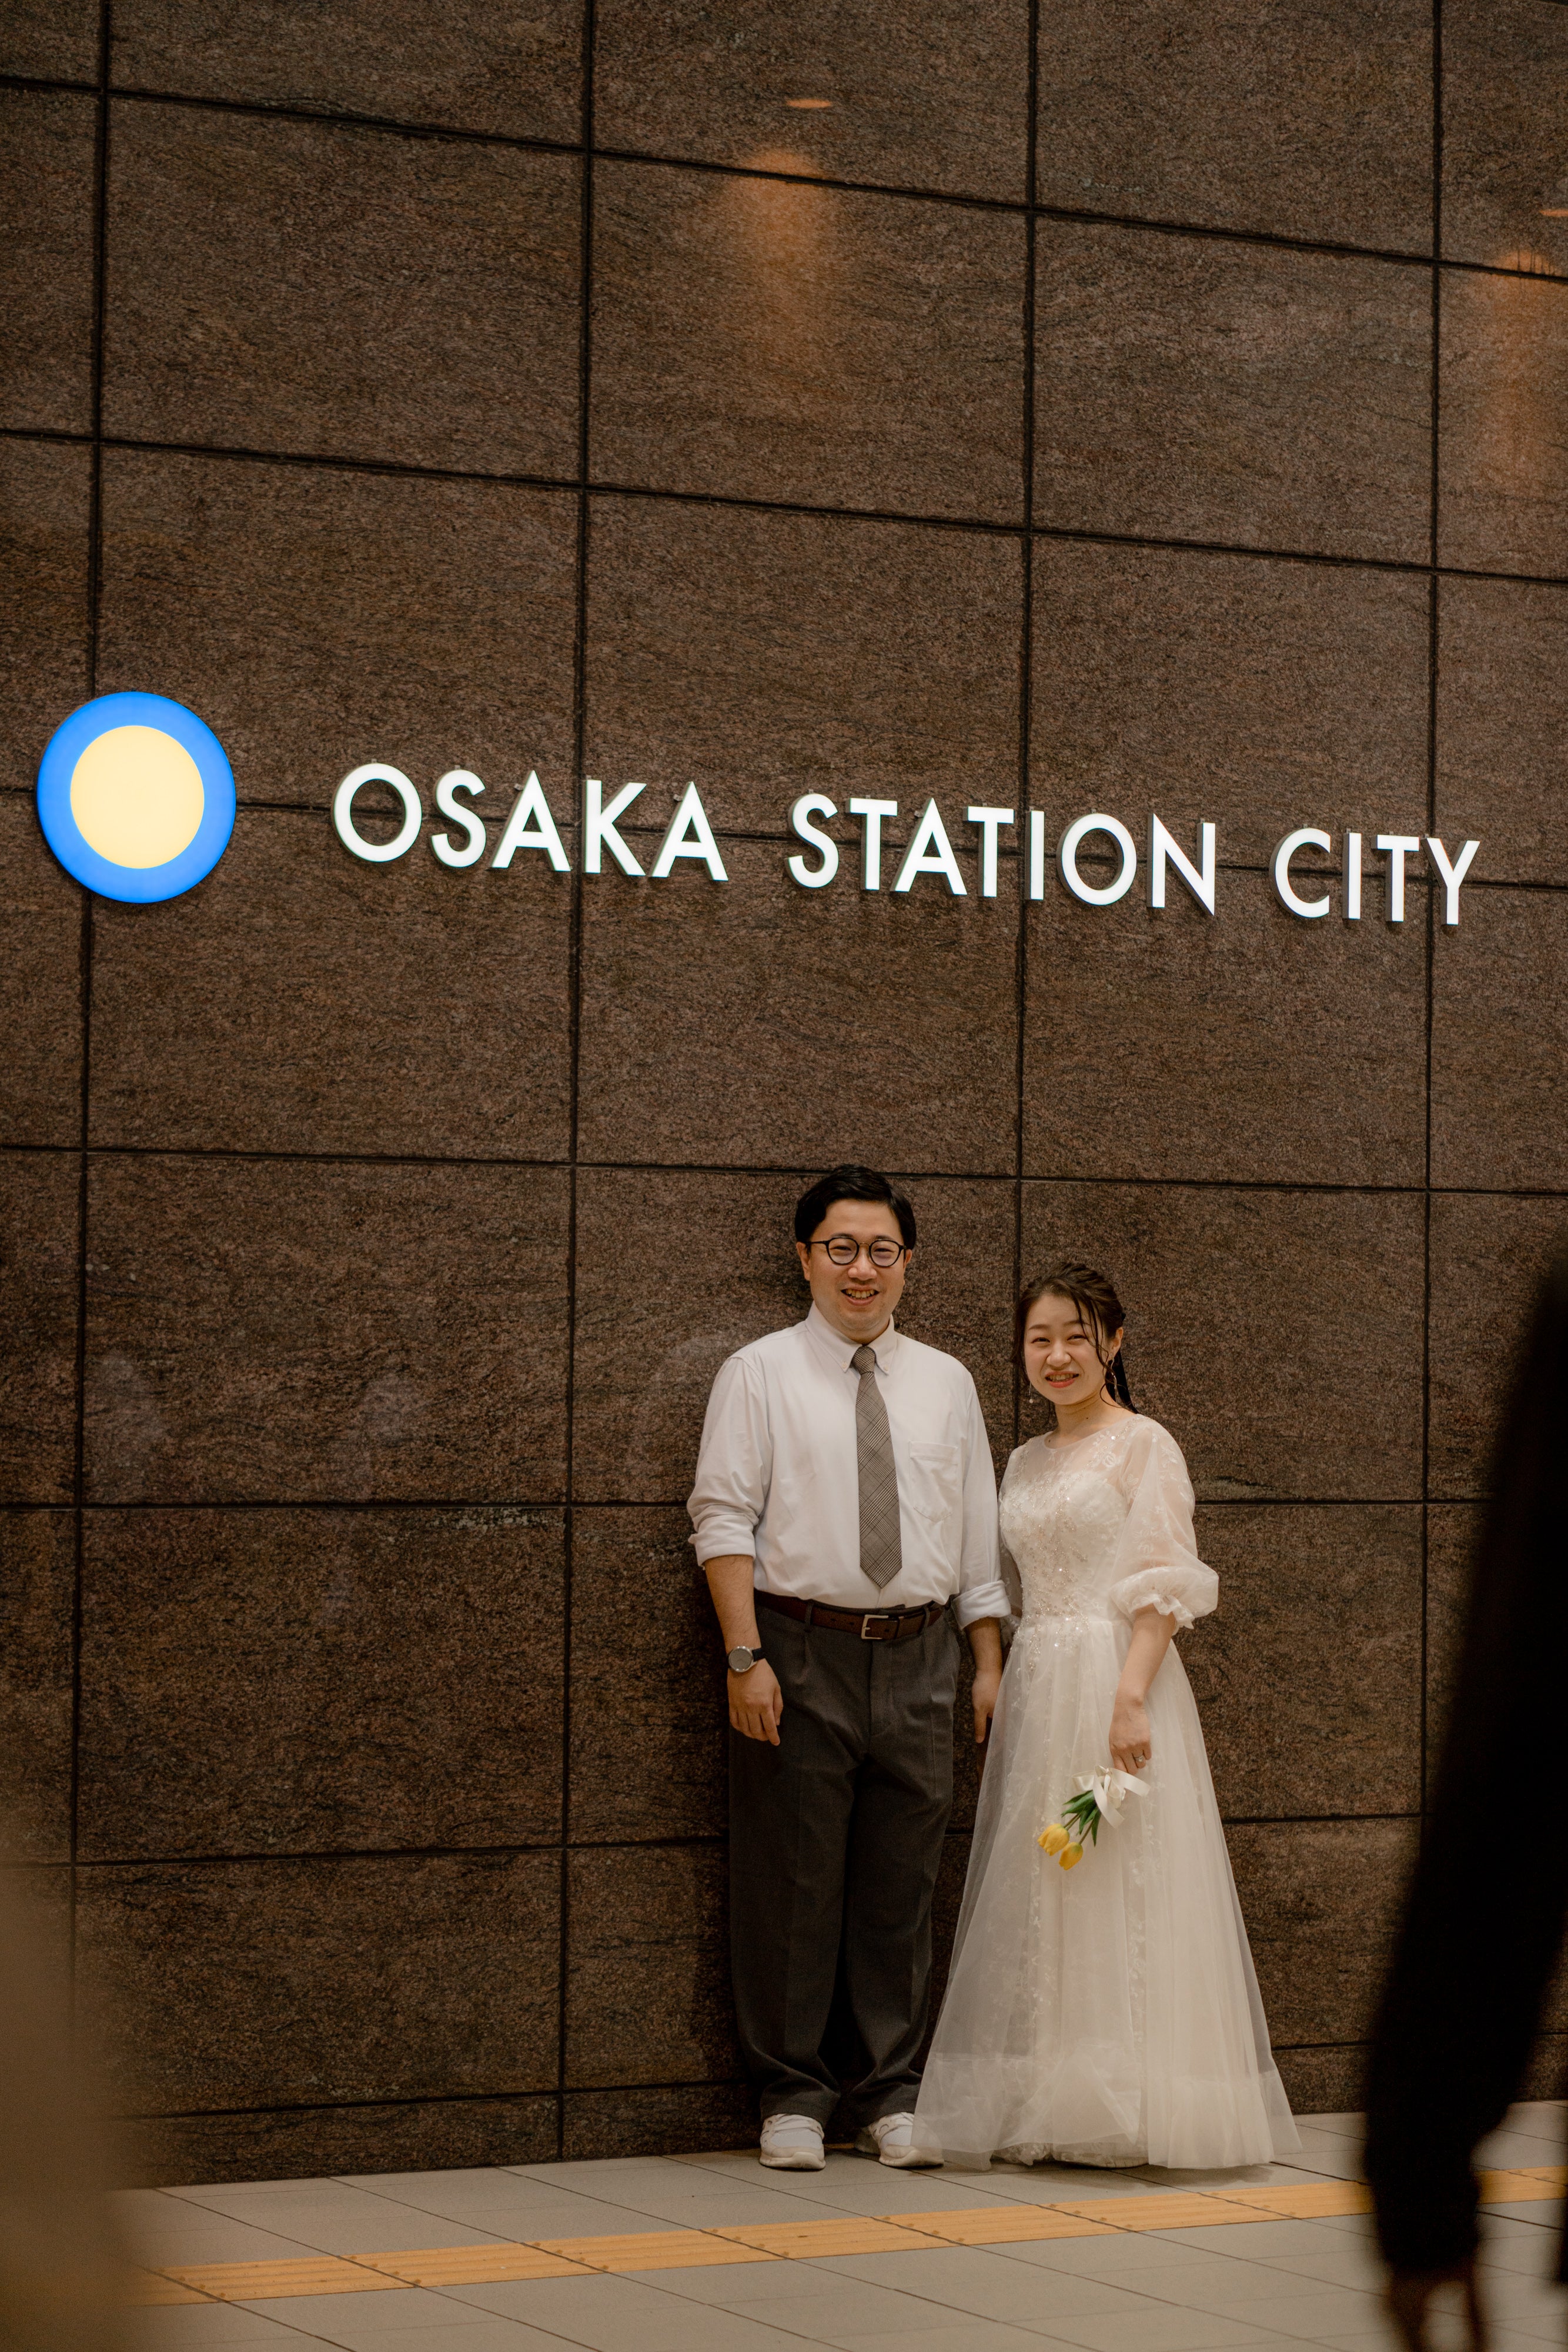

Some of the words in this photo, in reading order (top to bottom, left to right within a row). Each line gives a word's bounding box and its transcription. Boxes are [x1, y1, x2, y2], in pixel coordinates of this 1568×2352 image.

[332, 763, 729, 881] OSAKA
[787, 792, 1216, 916] STATION
[1273, 827, 1481, 926] CITY
